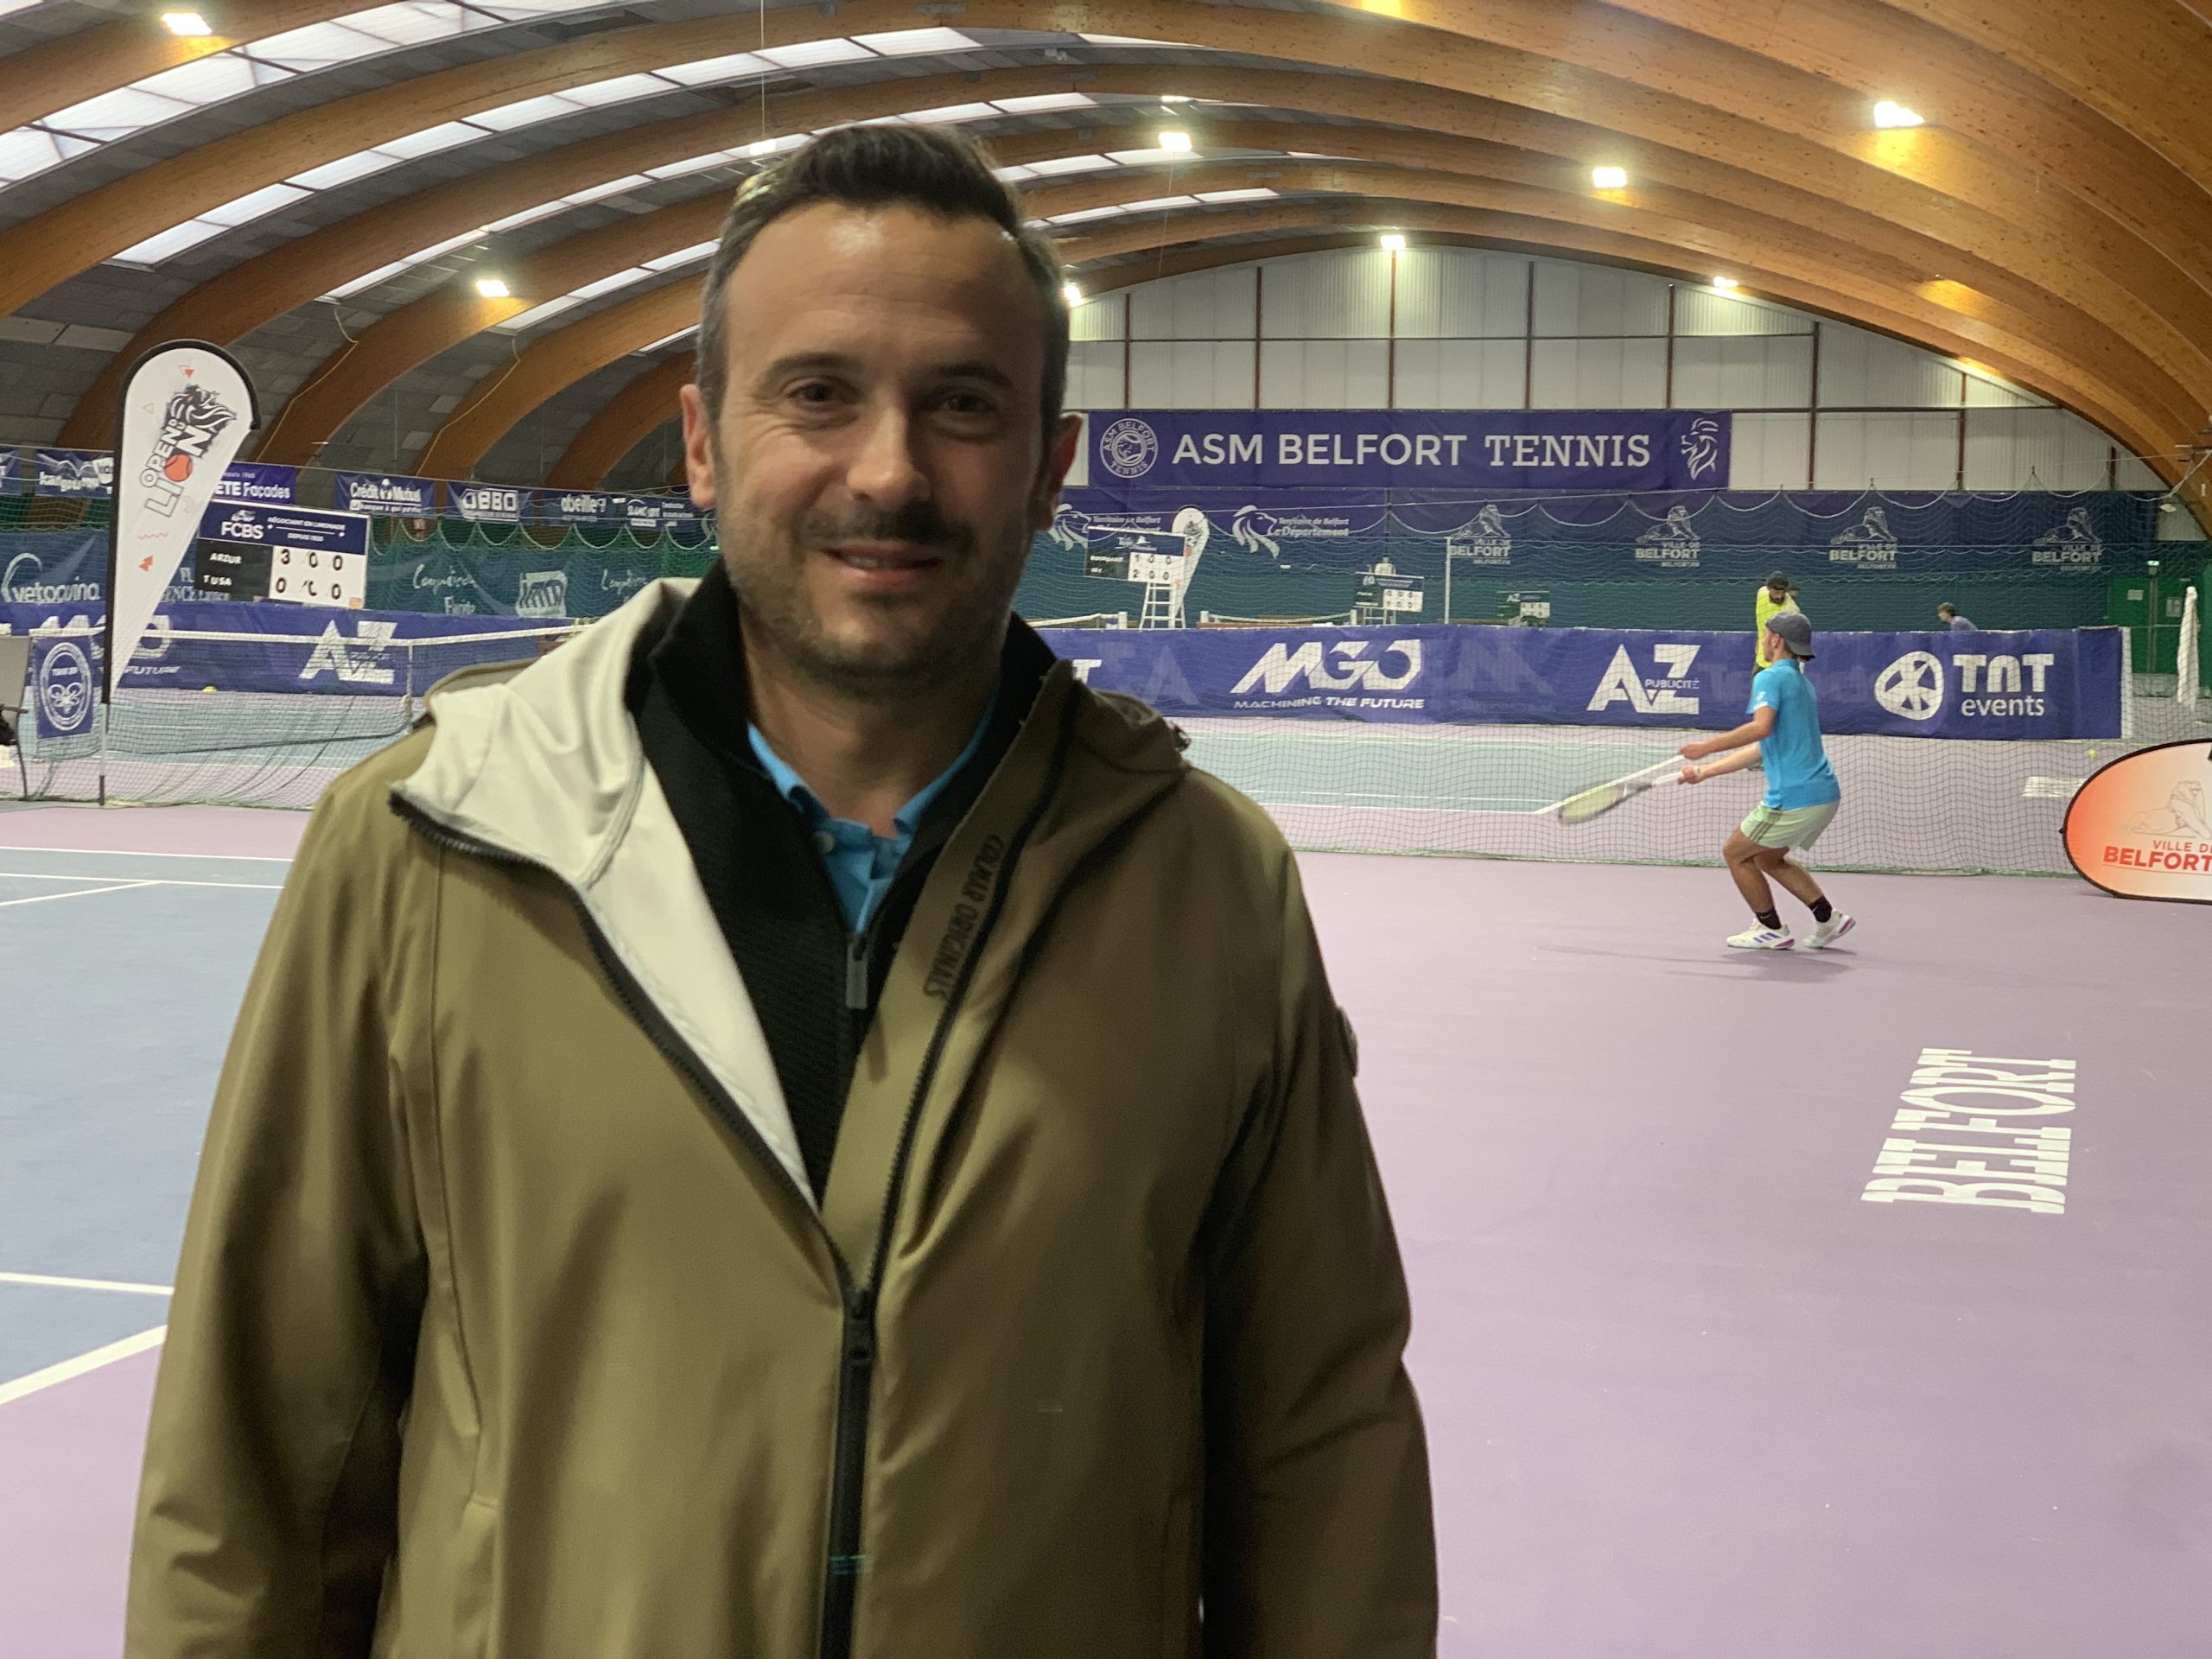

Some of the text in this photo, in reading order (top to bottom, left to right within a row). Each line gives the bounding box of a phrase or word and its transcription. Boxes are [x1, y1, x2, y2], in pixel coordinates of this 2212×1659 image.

[139, 424, 183, 488] OPEN
[1172, 434, 1650, 467] ASM BELFORT TENNIS
[350, 480, 422, 503] Crédit Mutuel
[220, 521, 264, 540] FCBS
[281, 549, 343, 571] 3 0 0
[1451, 545, 1510, 556] BELFORT
[1635, 548, 1700, 559] BELFORT
[1829, 550, 1896, 561] BELFORT
[2032, 550, 2102, 563] BELFORT
[276, 577, 286, 593] 0
[332, 583, 341, 600] 0
[1230, 639, 1421, 694] MGO
[1644, 678, 1700, 690] PUBLICITÉ
[1234, 696, 1322, 709] MACHINING
[1325, 696, 1357, 707] THE
[1359, 697, 1426, 709] FUTURE
[1961, 697, 2046, 717] events
[2153, 839, 2212, 854] VILLE D
[2102, 845, 2212, 873] BELFORT
[1860, 1047, 2077, 1215] BELFORT
